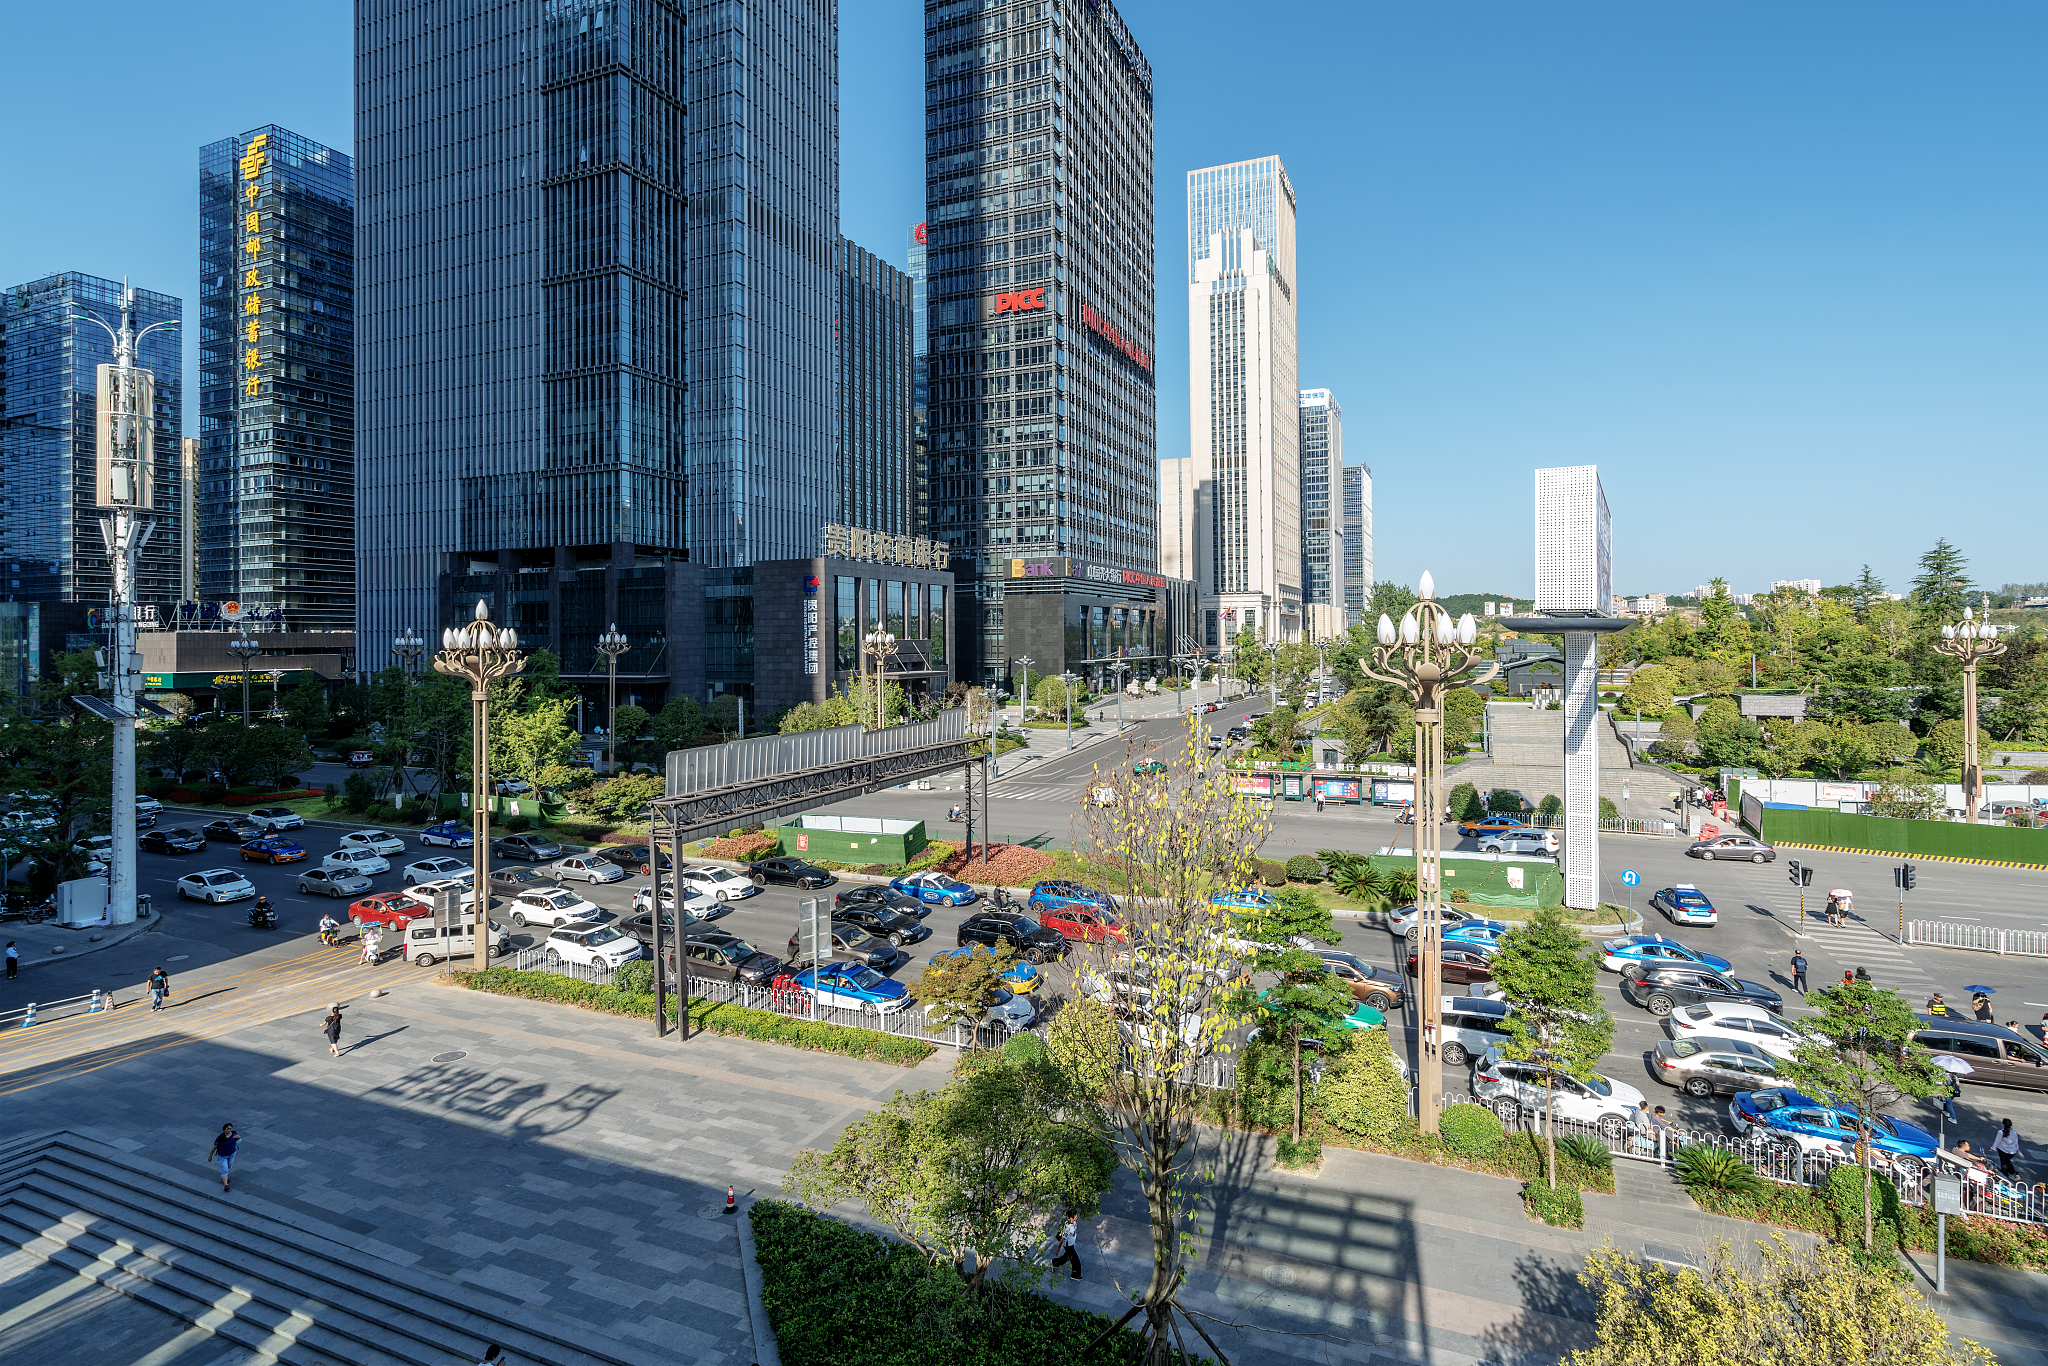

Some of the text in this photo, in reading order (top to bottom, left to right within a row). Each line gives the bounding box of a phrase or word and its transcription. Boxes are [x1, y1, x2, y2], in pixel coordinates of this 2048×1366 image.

[245, 181, 262, 397] 中国邮政储蓄银行
[996, 287, 1045, 314] PICC
[826, 523, 950, 569] 贵阳农商银行
[1012, 558, 1054, 578] Bank
[808, 599, 818, 674] 贵阳产控集团
